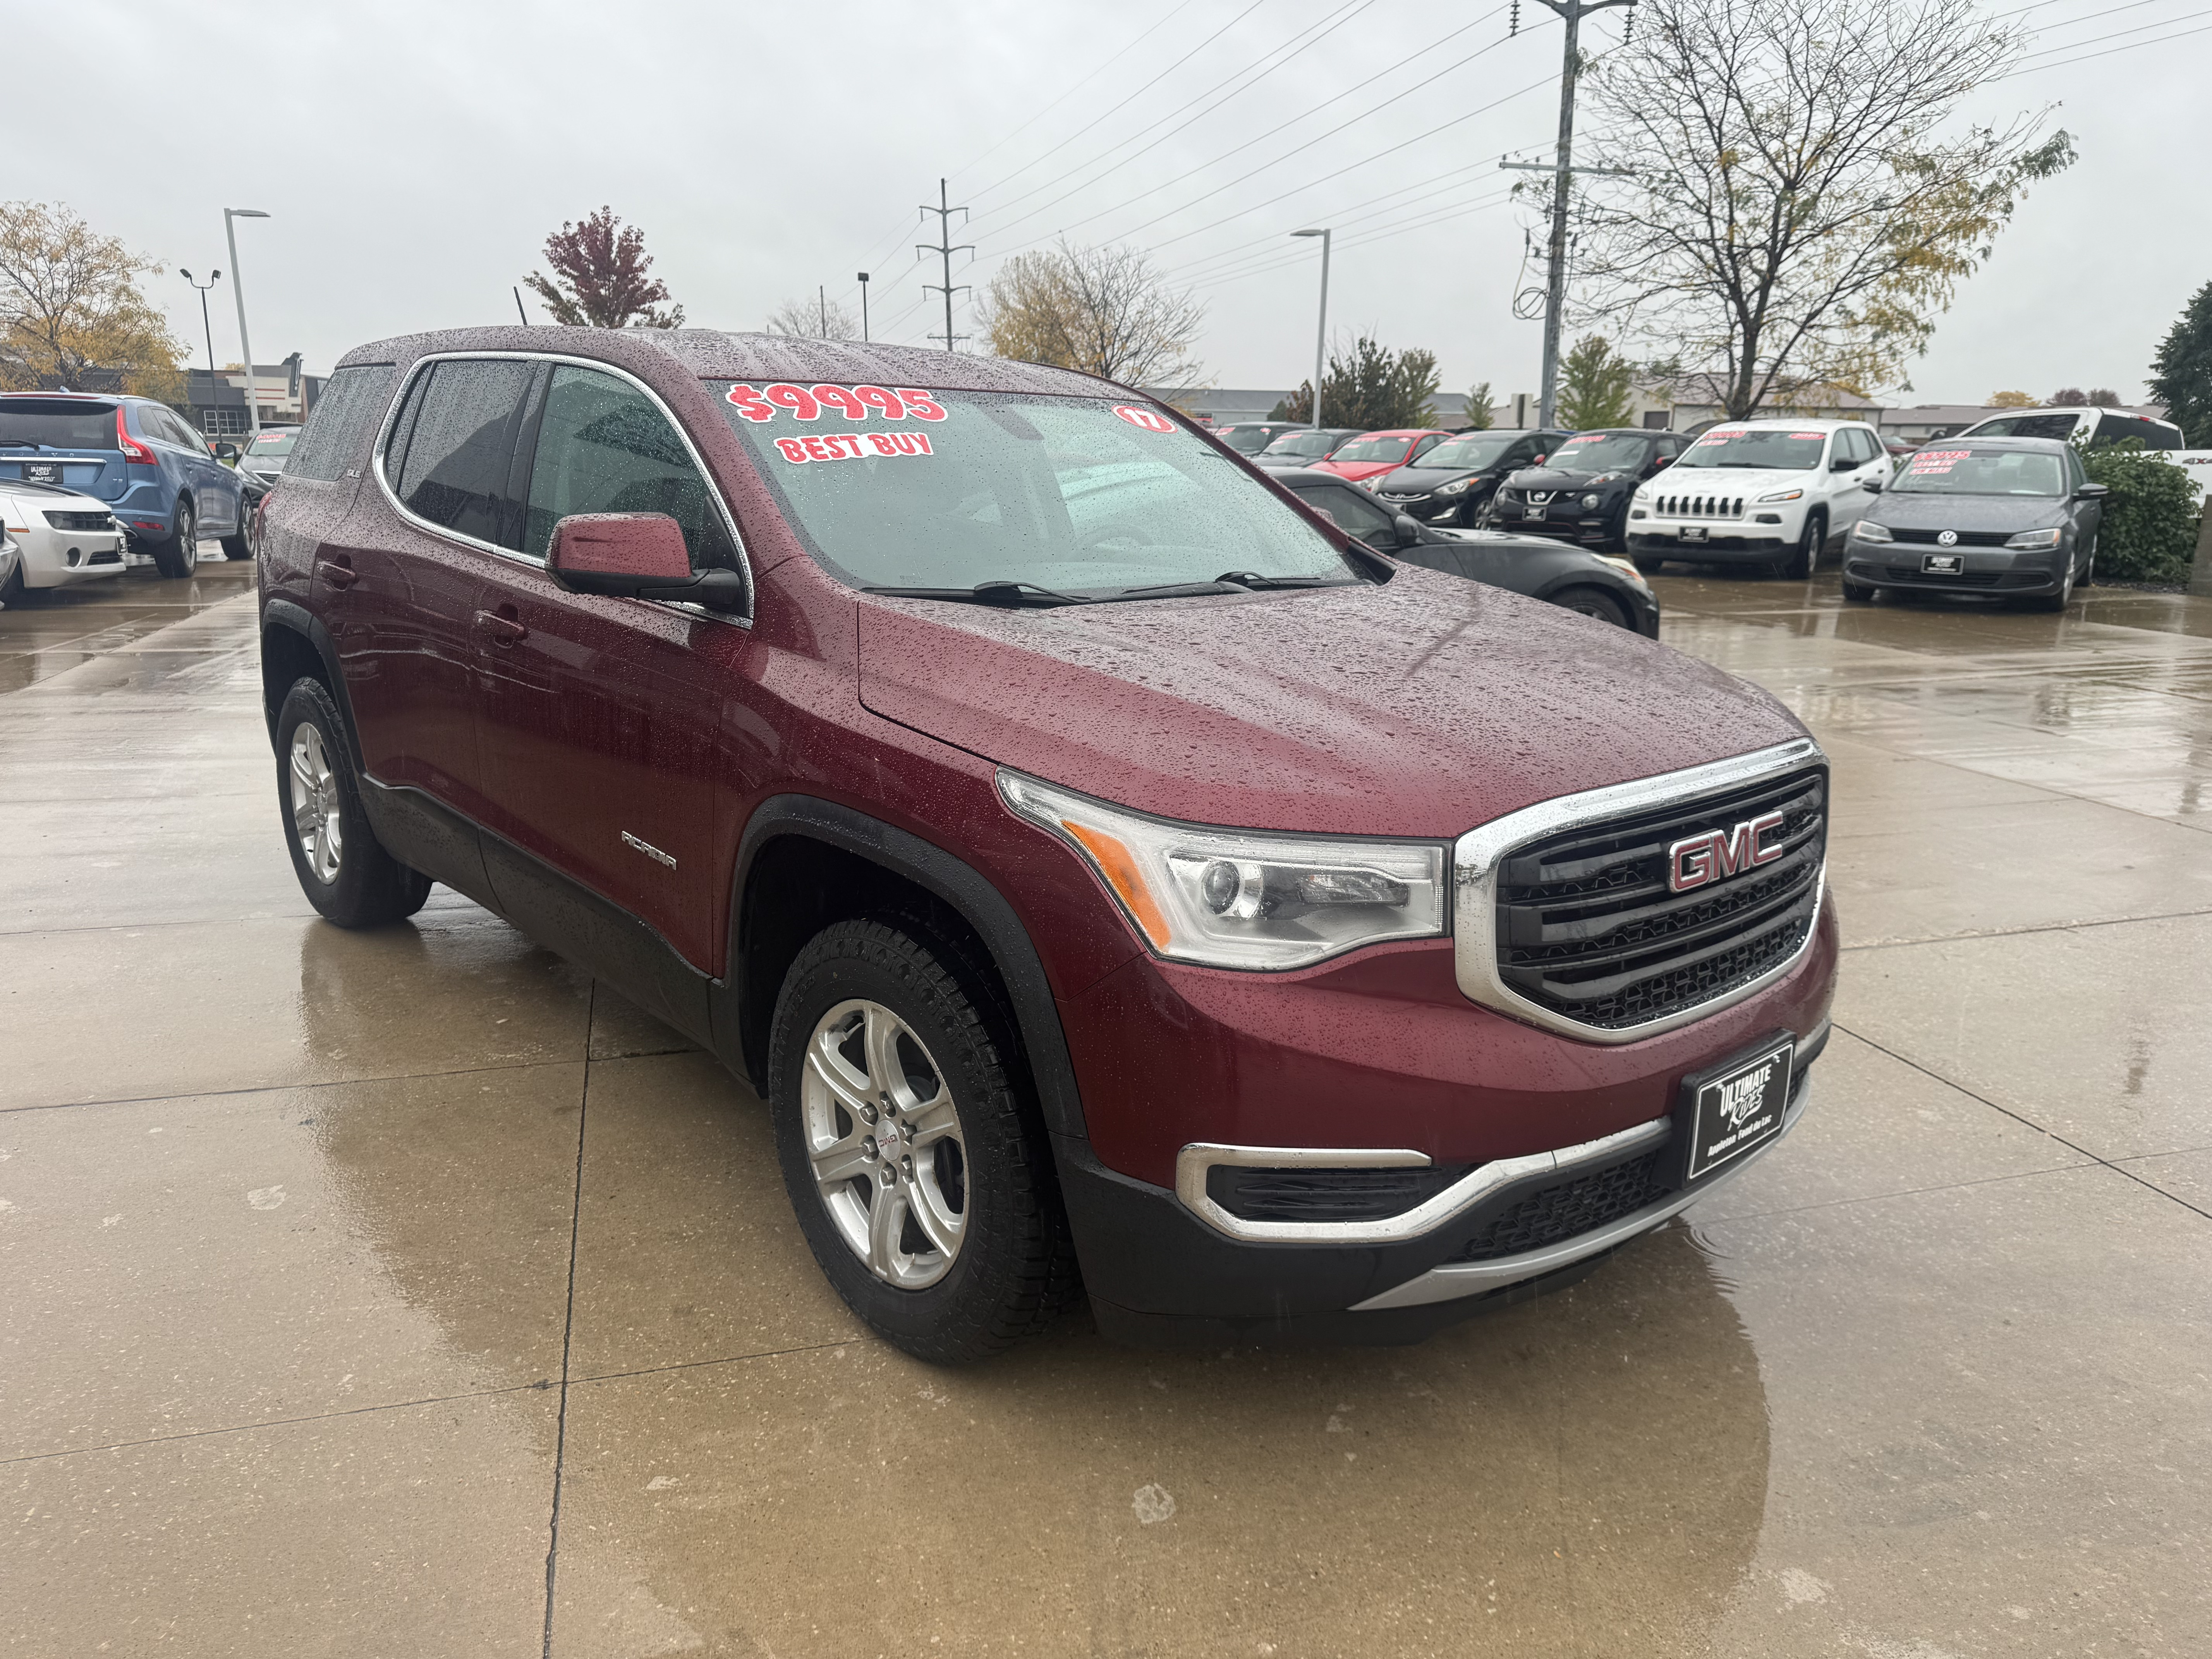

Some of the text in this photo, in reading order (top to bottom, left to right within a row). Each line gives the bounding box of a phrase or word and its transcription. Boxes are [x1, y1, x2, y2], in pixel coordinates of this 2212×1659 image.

[727, 384, 946, 422] $9995
[1123, 408, 1162, 429] 17
[776, 433, 932, 463] BEST BUY
[347, 469, 361, 479] SLE
[622, 831, 677, 871] ACADIA
[1669, 811, 1783, 893] GMC
[1720, 1064, 1772, 1117] ULTIMATE
[878, 1134, 898, 1147] GMC
[1707, 1134, 1736, 1157] Appleton
